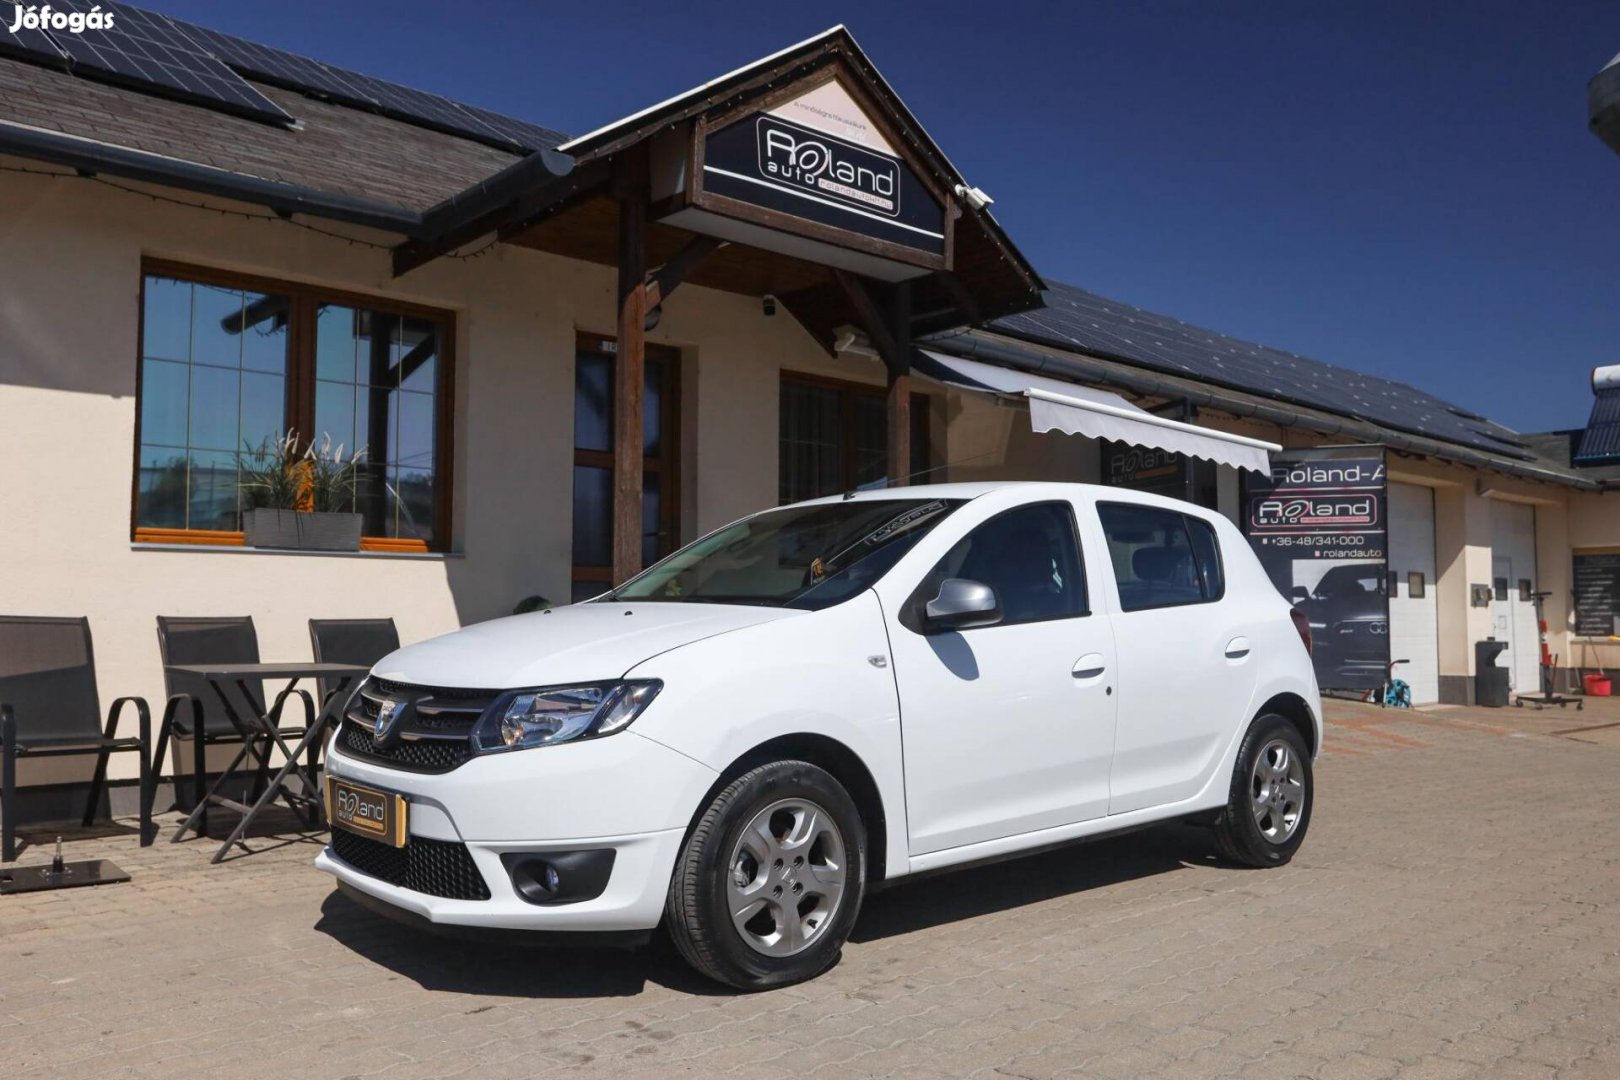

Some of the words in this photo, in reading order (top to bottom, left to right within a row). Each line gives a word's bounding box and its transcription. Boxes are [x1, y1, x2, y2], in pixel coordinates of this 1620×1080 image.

[766, 129, 893, 196] Roland
[767, 161, 815, 185] auto
[1260, 500, 1369, 518] Roland
[1272, 536, 1364, 546] +36-48/341-000
[1323, 549, 1382, 558] rolandauto
[338, 789, 384, 820] Roland
